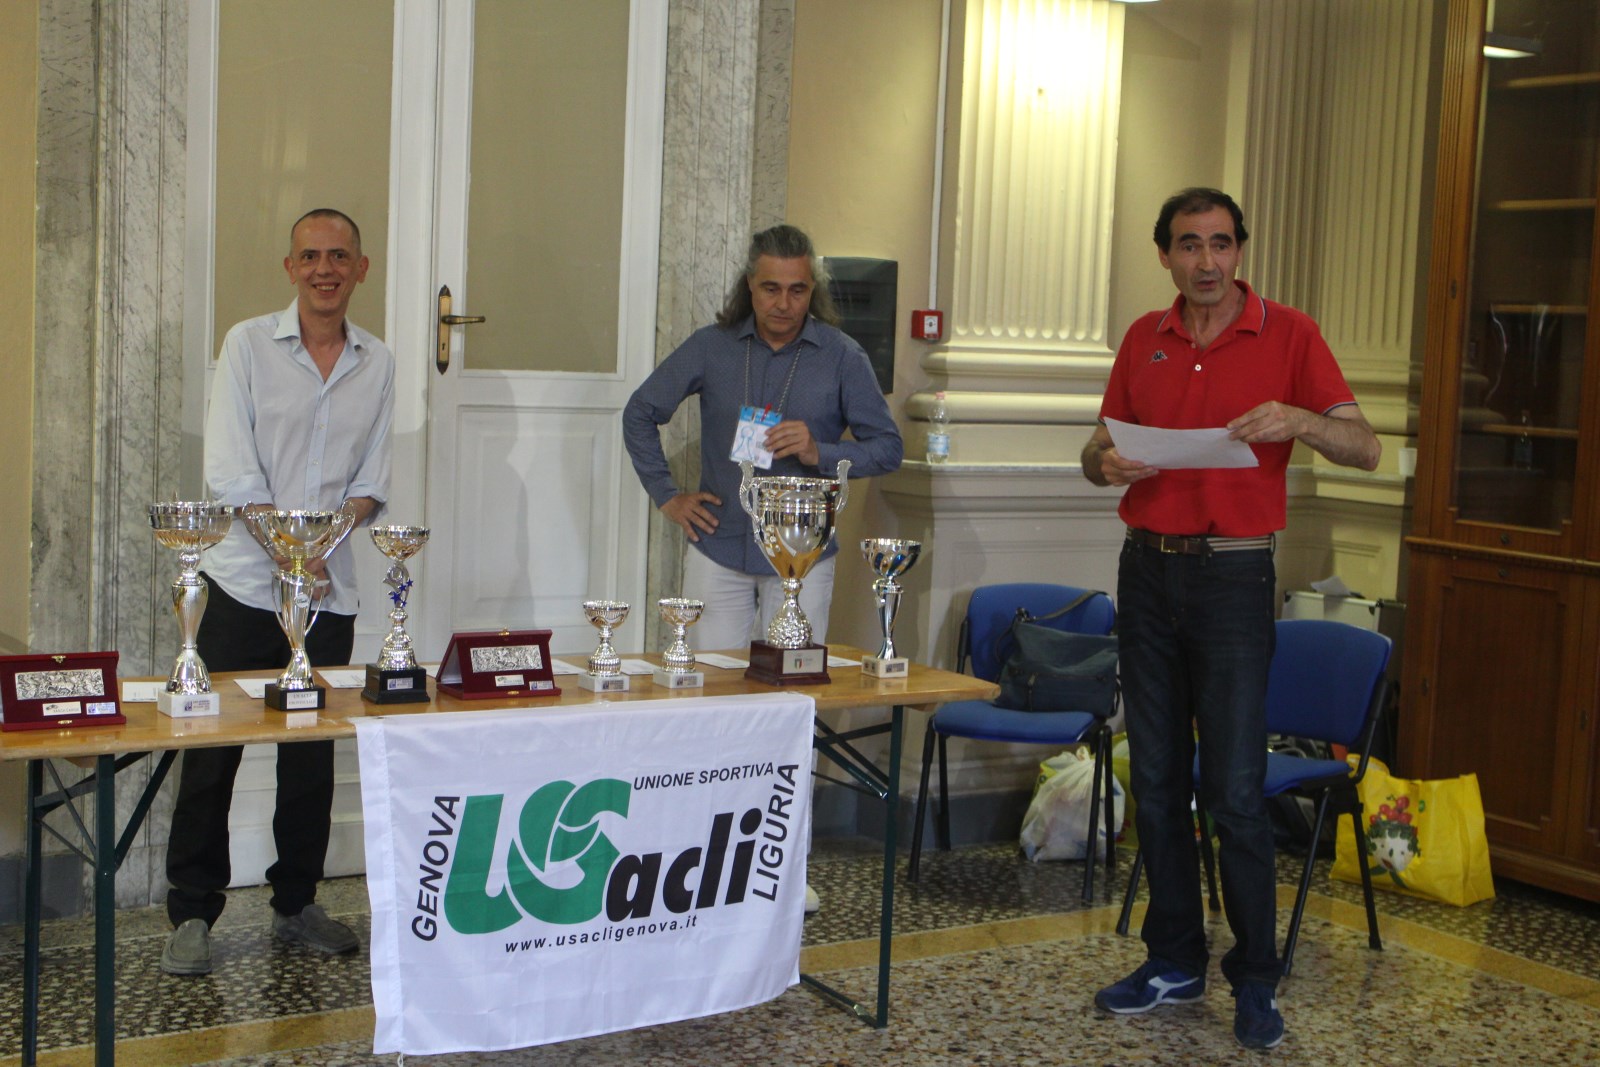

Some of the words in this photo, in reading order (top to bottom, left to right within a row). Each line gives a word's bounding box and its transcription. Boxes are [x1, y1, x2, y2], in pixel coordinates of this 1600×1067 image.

[633, 772, 695, 791] UNIONE
[698, 762, 775, 784] SPORTIVA
[411, 796, 461, 942] GENOVA
[752, 764, 799, 902] LIGURIA
[505, 915, 698, 953] www.usacligenova.it
